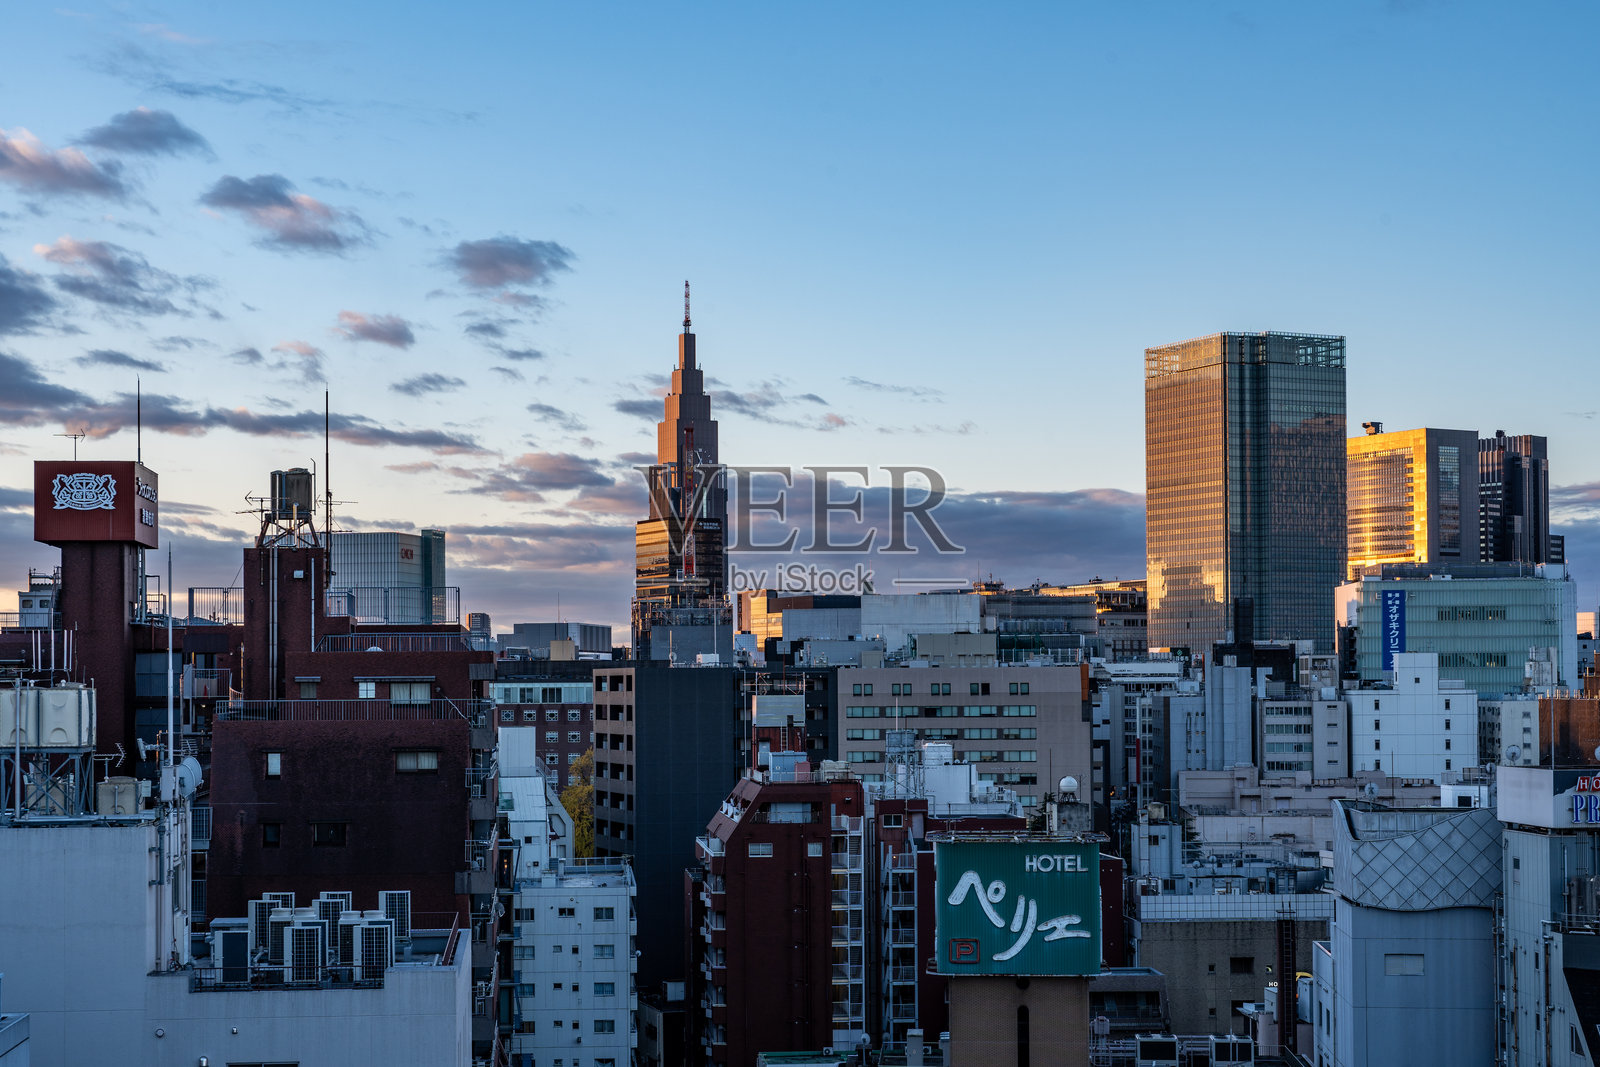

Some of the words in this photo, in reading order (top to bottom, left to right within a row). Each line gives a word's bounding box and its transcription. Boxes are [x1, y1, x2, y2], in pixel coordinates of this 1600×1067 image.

[1389, 605, 1400, 668] オザキクリニ
[1025, 854, 1089, 873] HOTEL
[948, 870, 1091, 961] ペリエ
[955, 943, 974, 960] P
